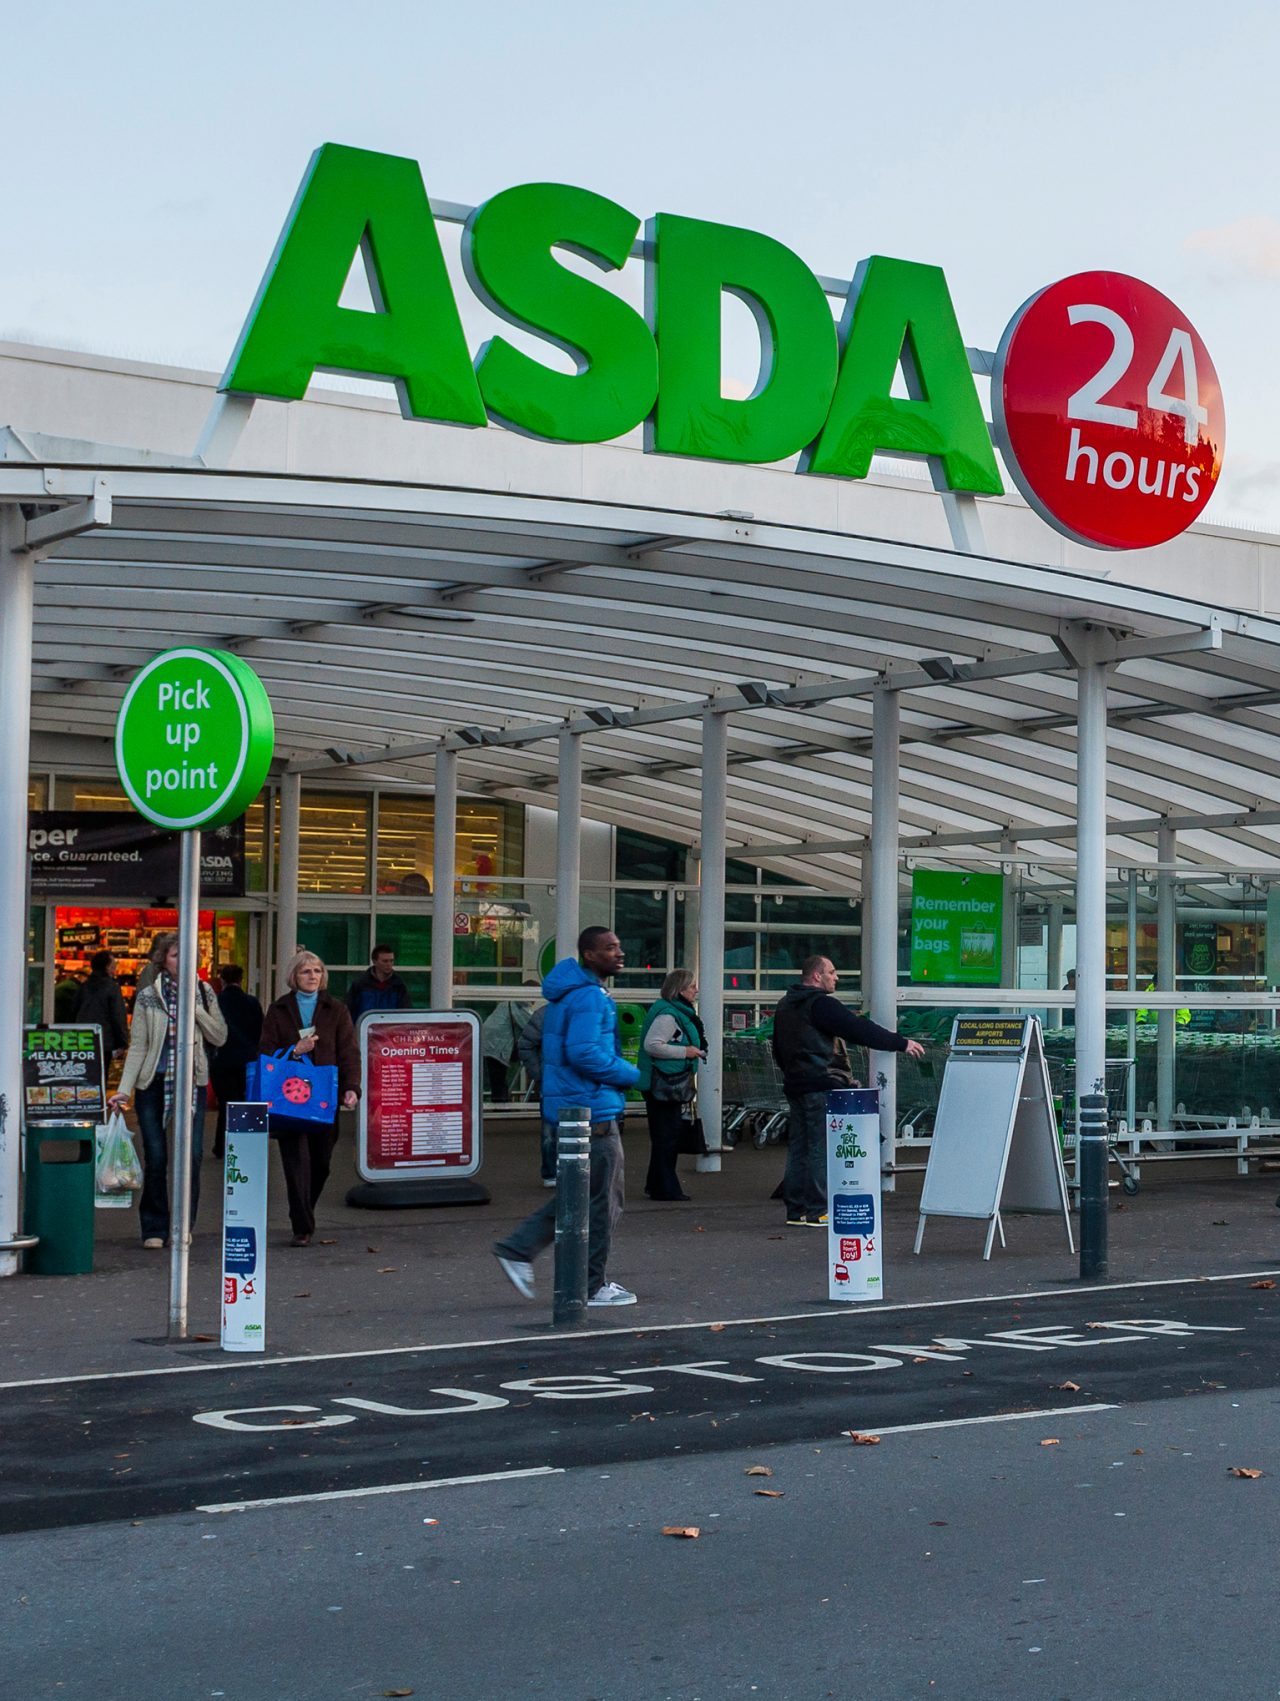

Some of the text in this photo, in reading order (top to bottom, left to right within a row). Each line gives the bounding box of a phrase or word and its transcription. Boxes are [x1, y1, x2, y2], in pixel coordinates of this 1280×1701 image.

[217, 141, 1004, 497] ASDA
[1067, 303, 1208, 447] 24
[1065, 428, 1201, 502] hours
[158, 679, 211, 711] Pick
[165, 722, 200, 752] up
[145, 760, 218, 798] point
[29, 828, 78, 849] per
[59, 851, 143, 862] Guaranteed.
[200, 856, 233, 868] ASDA
[915, 895, 997, 913] Remember
[914, 918, 949, 932] your
[914, 935, 950, 954] bags
[28, 1031, 95, 1051] FREE
[393, 1034, 445, 1043] CHRISTMAS
[28, 1051, 95, 1060] MEALS FOR
[381, 1045, 460, 1057] Opening Times
[840, 1132, 858, 1145] TEXT
[835, 1145, 867, 1159] SANTA
[192, 1318, 1246, 1432] CUSTOMER
